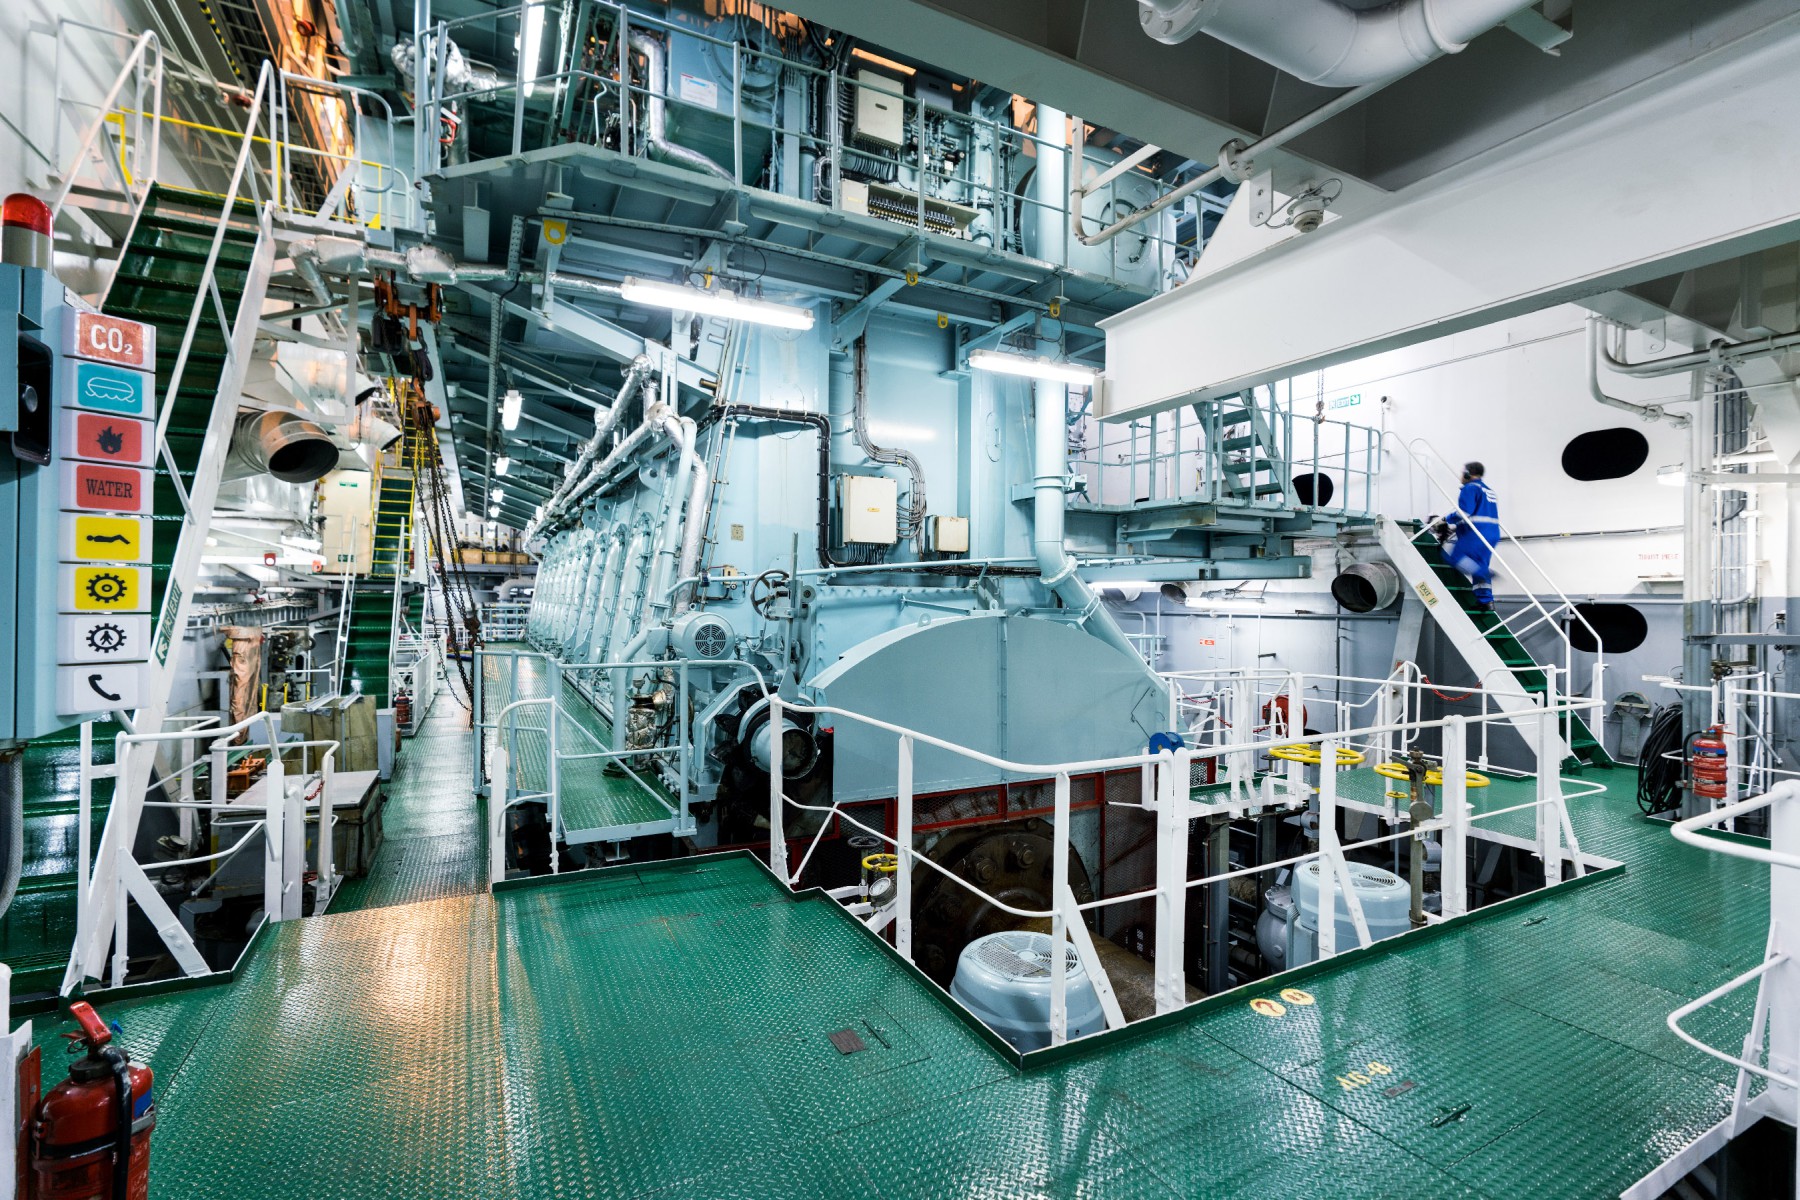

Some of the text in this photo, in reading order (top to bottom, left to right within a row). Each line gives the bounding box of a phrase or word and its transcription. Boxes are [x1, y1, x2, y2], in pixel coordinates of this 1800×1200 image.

[86, 478, 133, 498] WATER
[169, 582, 181, 613] EXIT
[1420, 584, 1431, 597] EXIT
